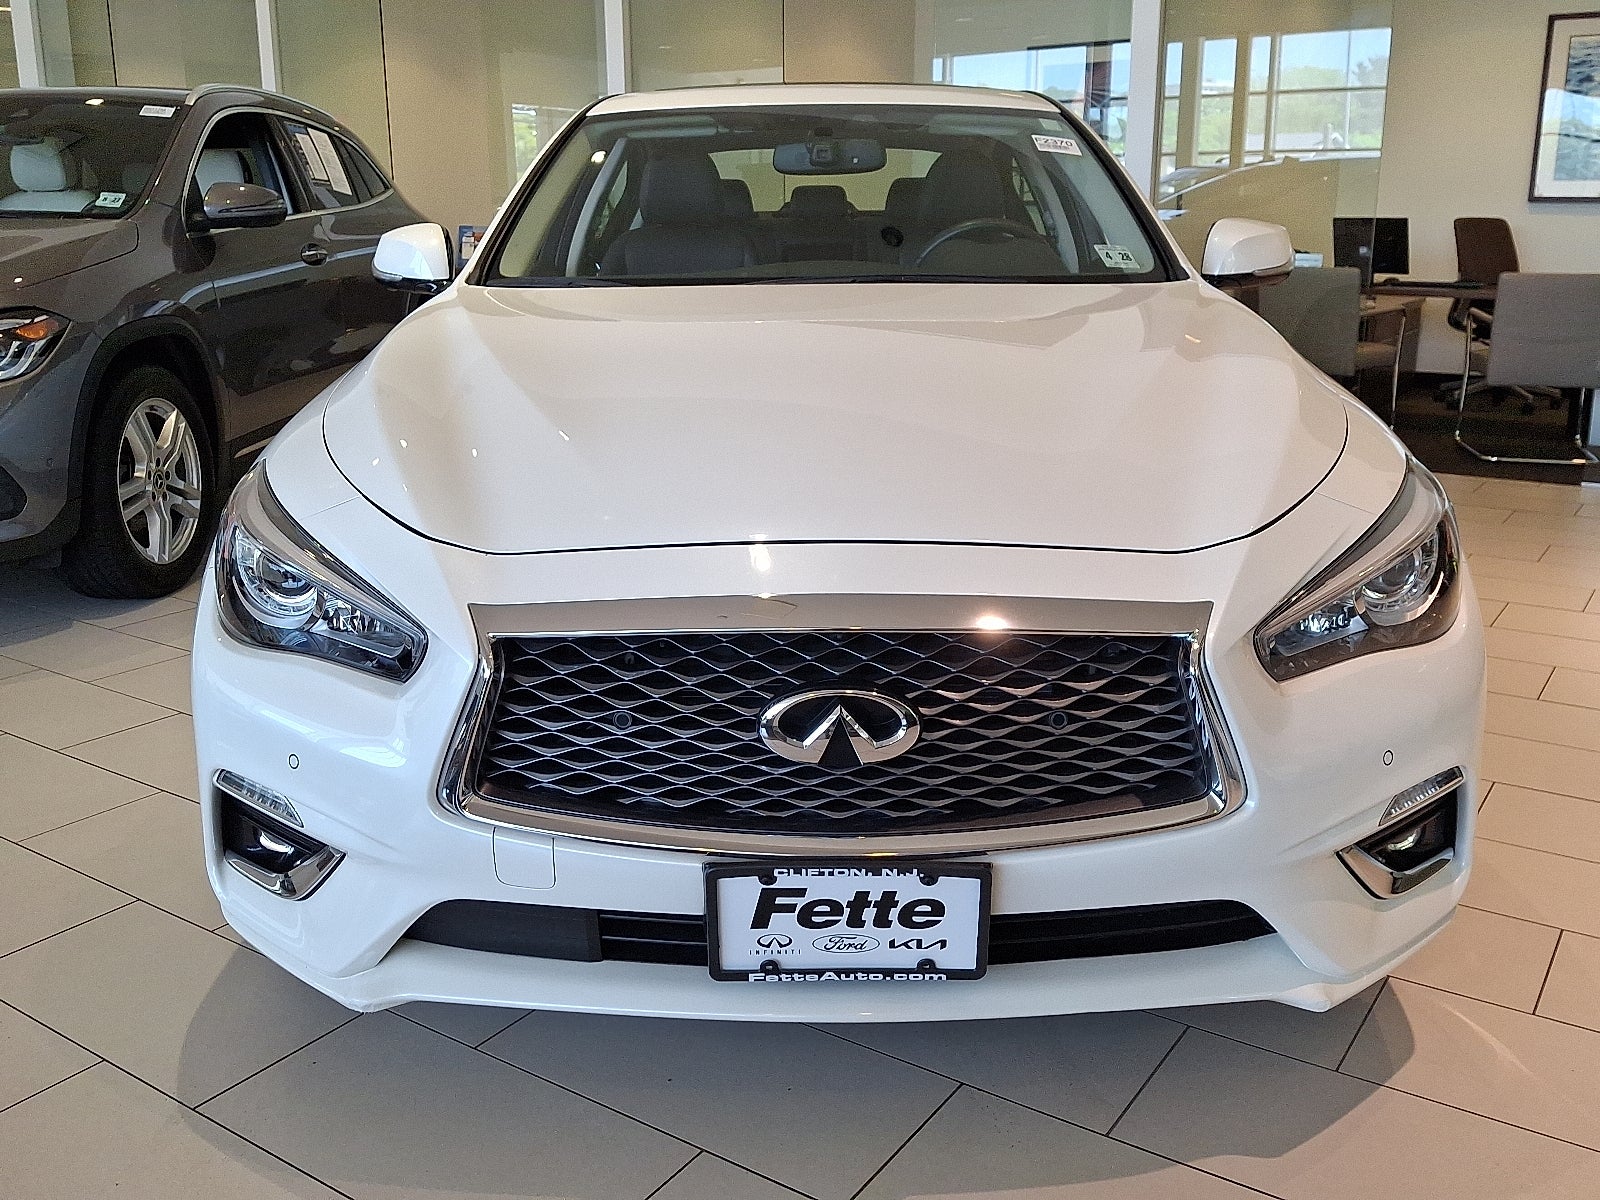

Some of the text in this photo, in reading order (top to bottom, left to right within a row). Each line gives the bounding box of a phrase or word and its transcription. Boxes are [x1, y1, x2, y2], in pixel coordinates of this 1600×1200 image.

[1105, 251, 1113, 261] 4
[749, 887, 946, 930] Fette
[823, 935, 868, 951] Ford
[748, 971, 947, 982] FetteAuto.com
